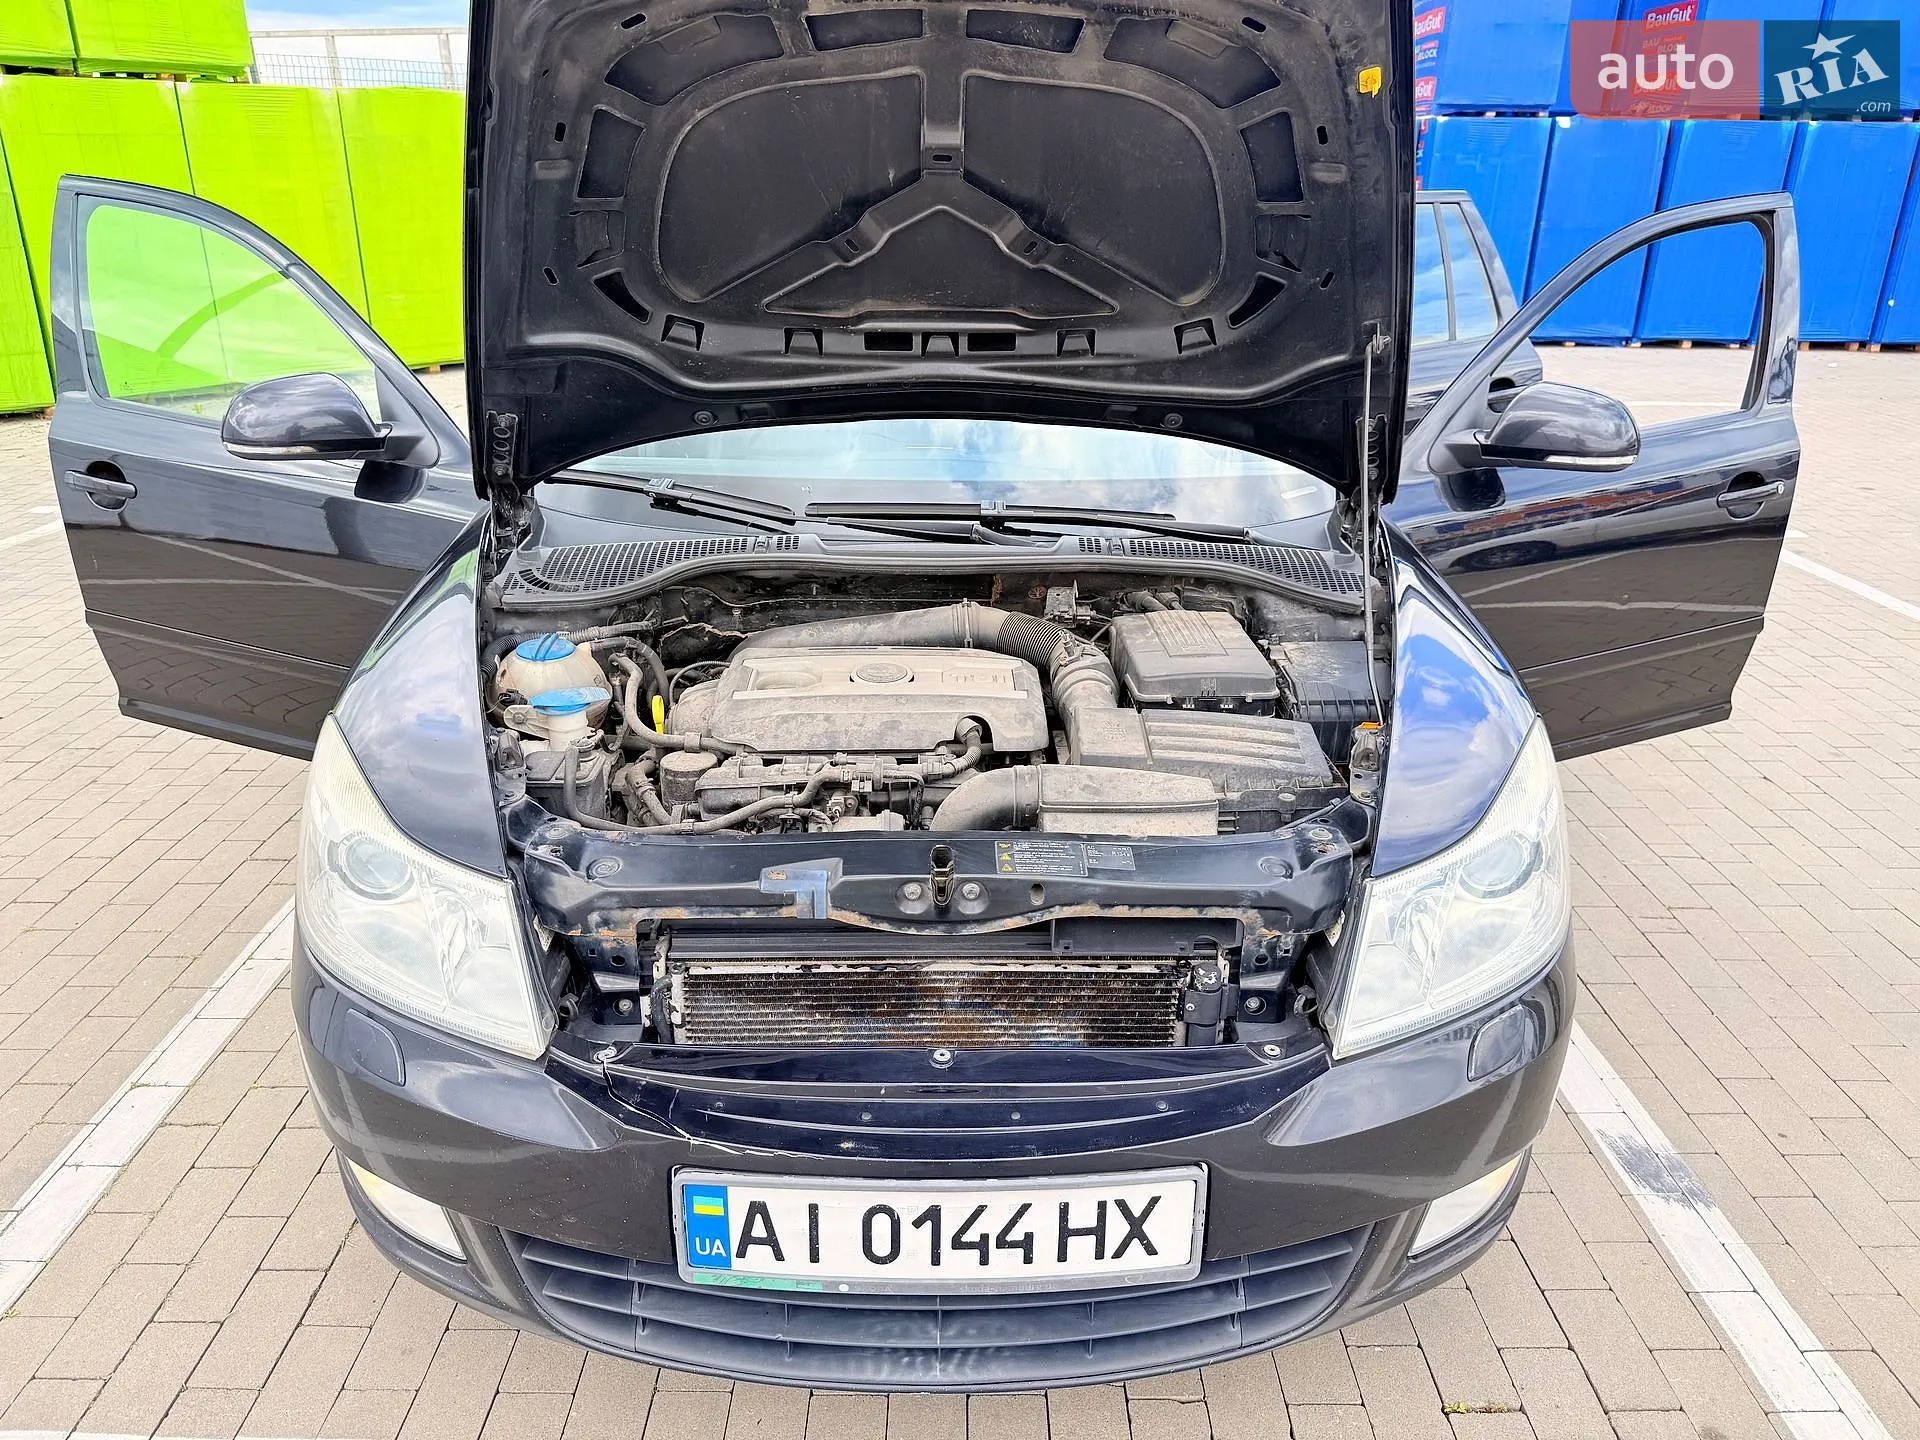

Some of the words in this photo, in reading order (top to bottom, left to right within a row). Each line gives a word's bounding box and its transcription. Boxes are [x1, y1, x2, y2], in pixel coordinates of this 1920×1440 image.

[1645, 5, 1692, 30] BauGut
[861, 1203, 1034, 1266] 0144
[1056, 1195, 1162, 1262] HX
[695, 1236, 727, 1257] UA
